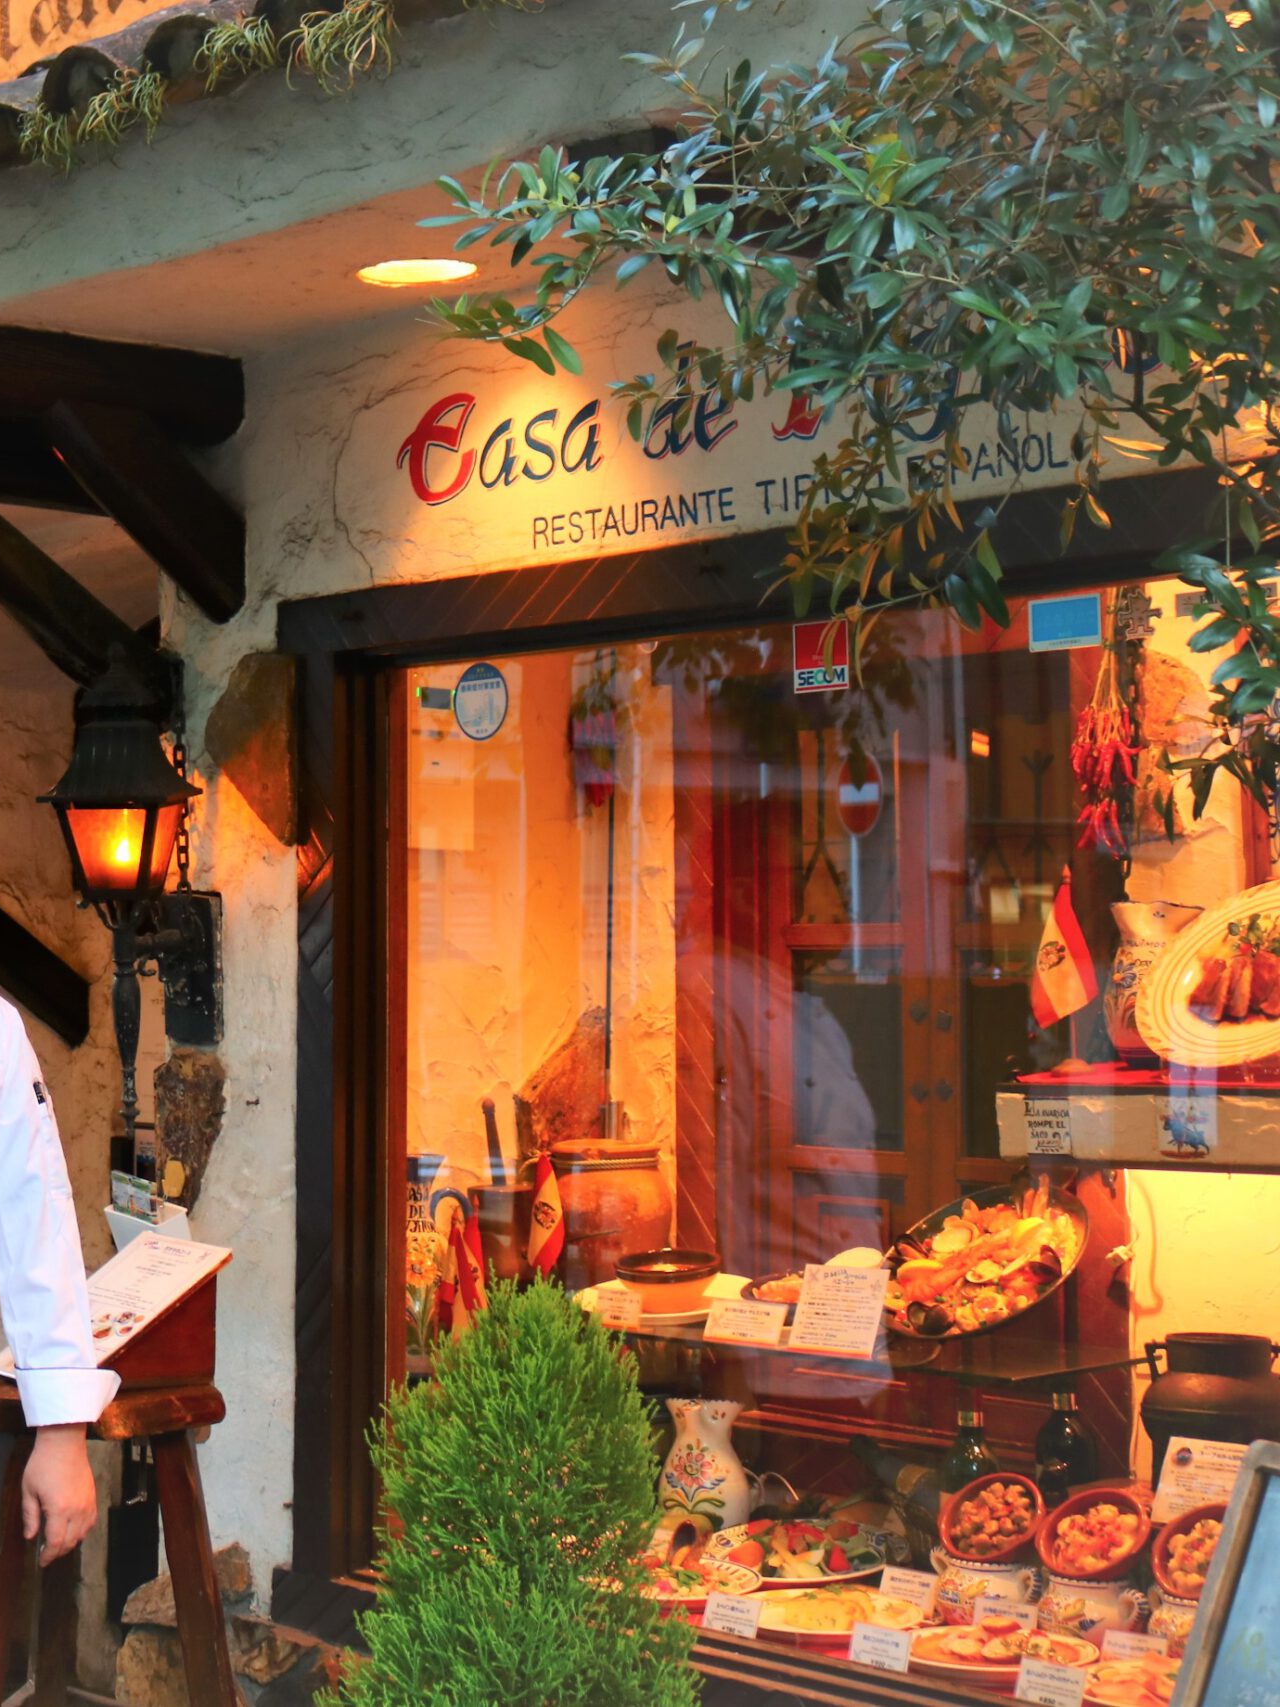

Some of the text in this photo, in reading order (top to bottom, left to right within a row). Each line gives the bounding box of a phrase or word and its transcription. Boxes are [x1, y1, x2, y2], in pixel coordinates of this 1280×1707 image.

[396, 392, 605, 506] Casa
[642, 340, 738, 460] de
[532, 486, 736, 550] RESTAURANTE
[755, 464, 884, 515] TIPIC
[797, 667, 845, 686] SECOM
[1028, 1120, 1067, 1129] ROMPE EL
